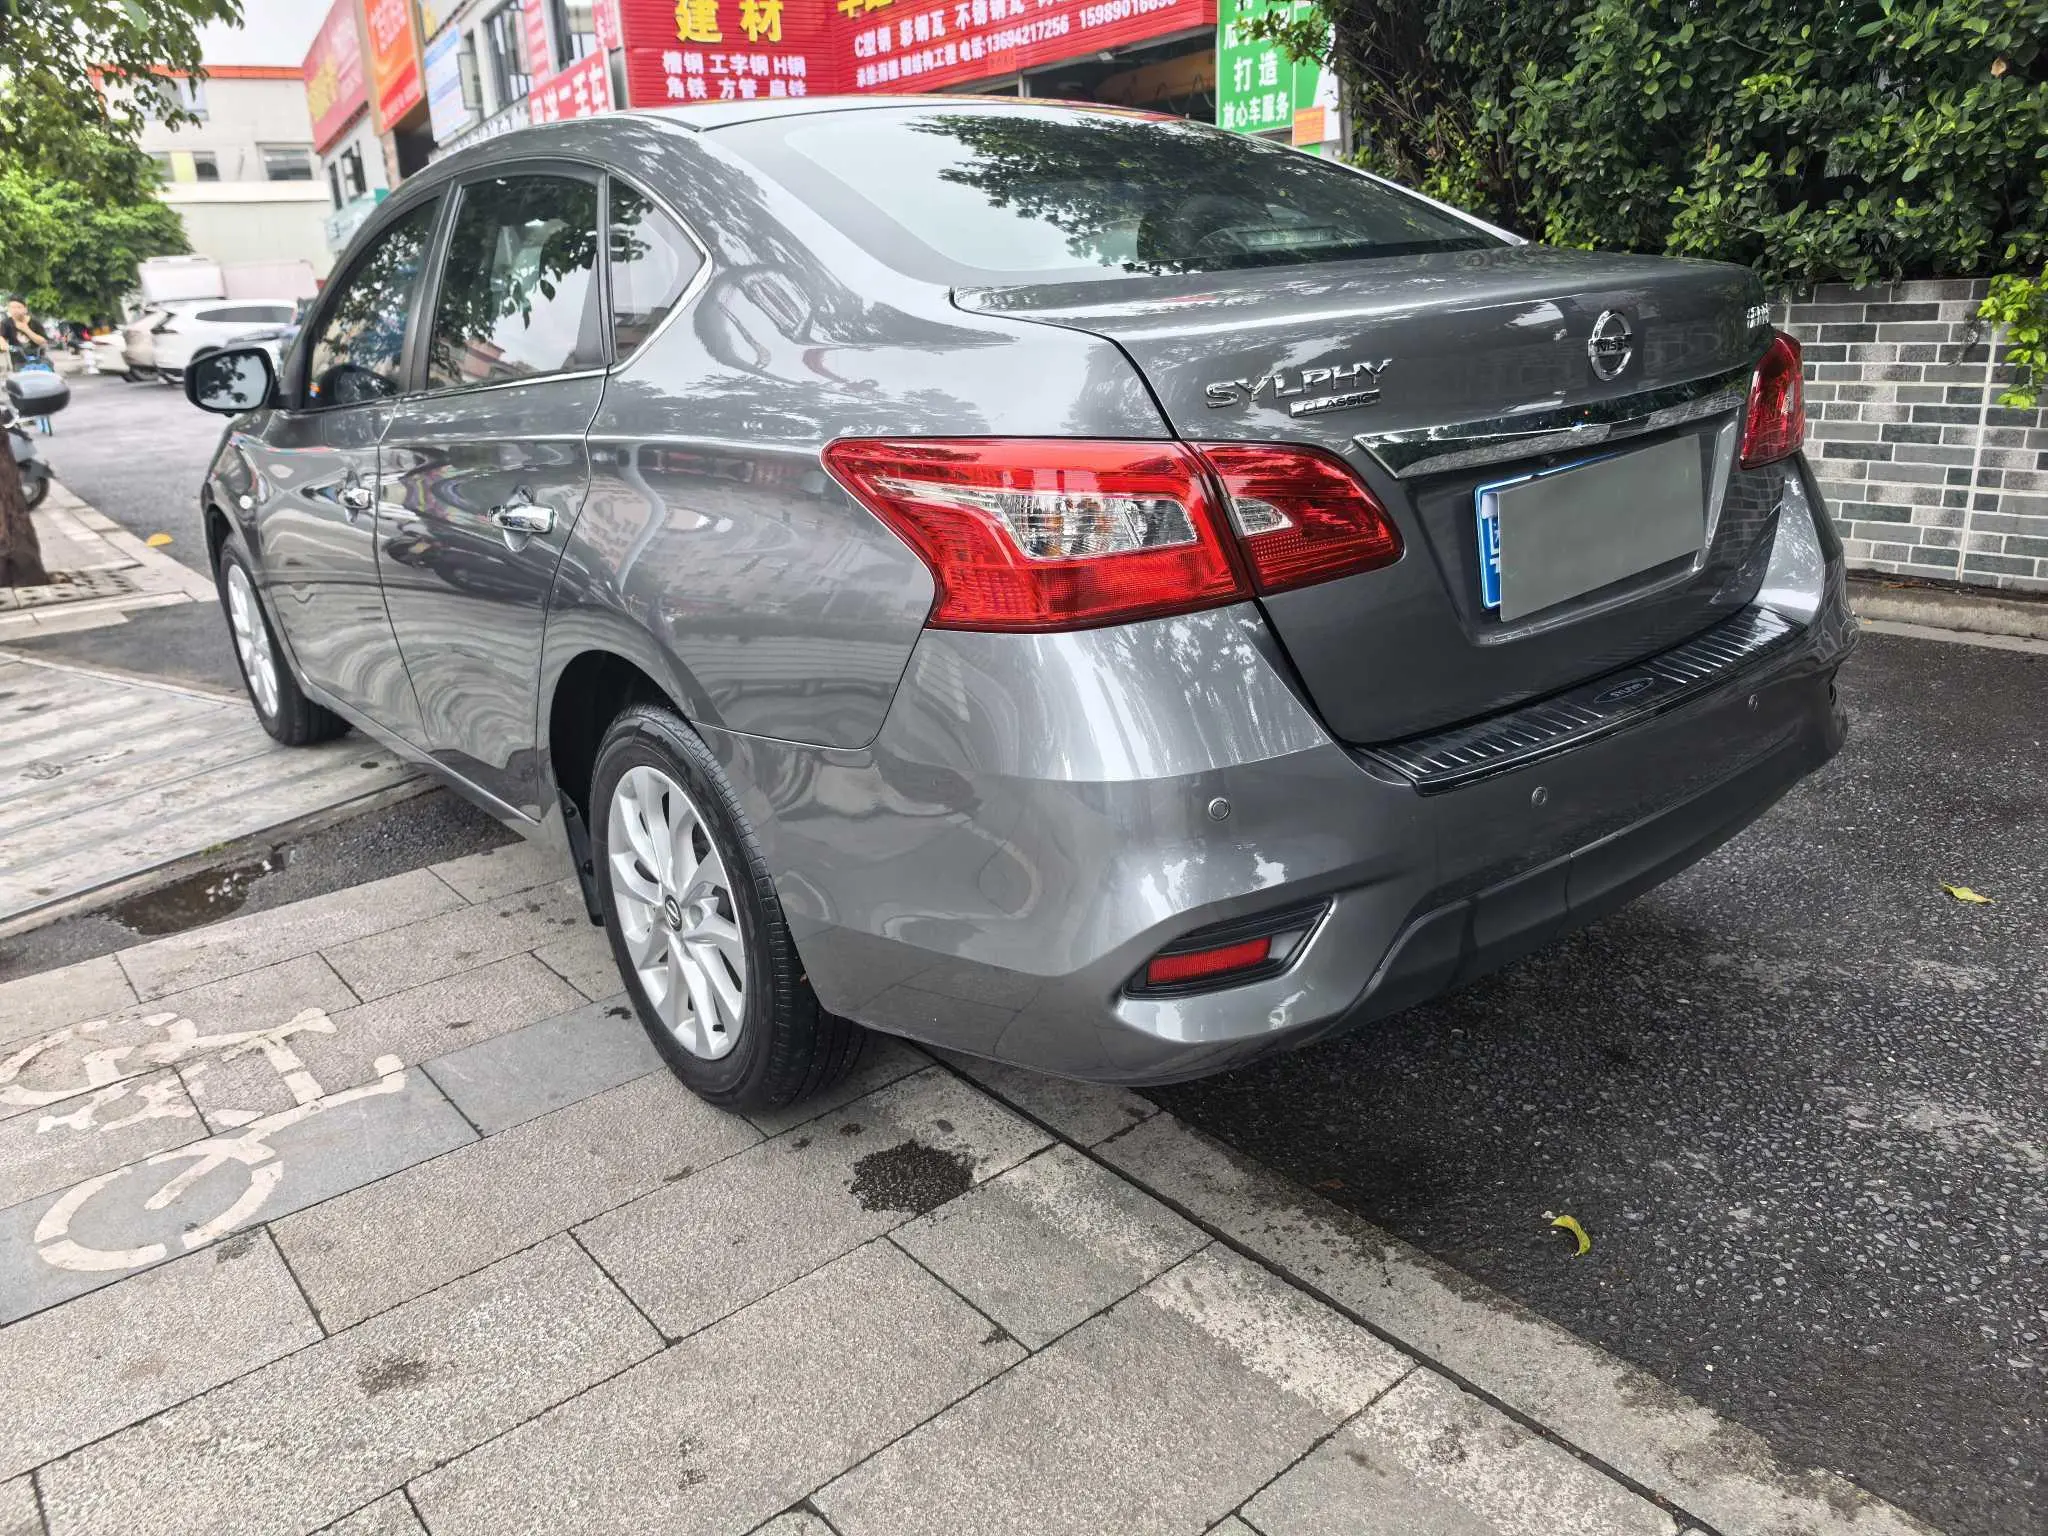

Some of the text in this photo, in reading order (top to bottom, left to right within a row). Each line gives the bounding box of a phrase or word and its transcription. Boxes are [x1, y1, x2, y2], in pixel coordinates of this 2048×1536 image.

[675, 0, 784, 43] 建材
[709, 54, 769, 76] 工字钢
[773, 56, 806, 77] H钢
[1233, 50, 1279, 92] 打造
[666, 76, 708, 99] 角铁
[718, 77, 757, 99] 方管
[1206, 358, 1392, 408] SYLPHY
